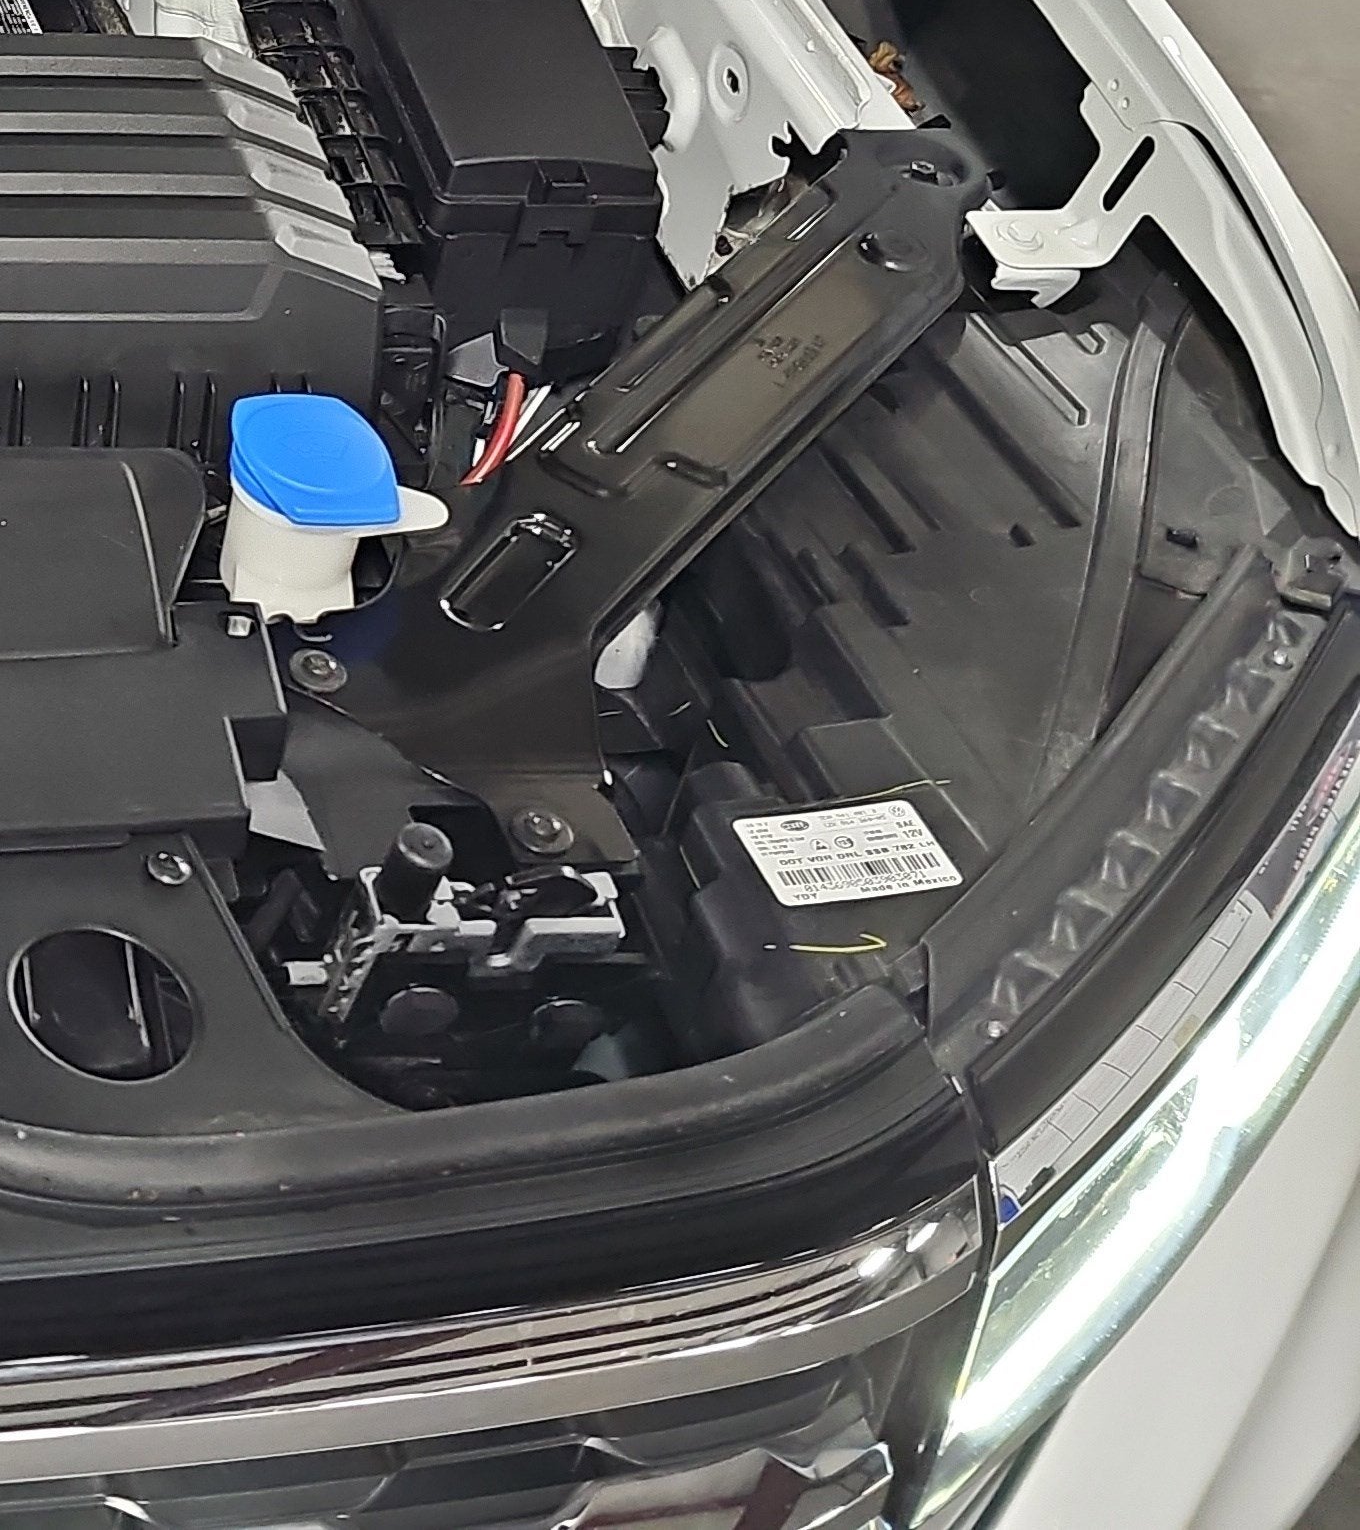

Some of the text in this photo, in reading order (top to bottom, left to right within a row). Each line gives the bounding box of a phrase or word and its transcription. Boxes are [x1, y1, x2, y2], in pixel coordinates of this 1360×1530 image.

[896, 820, 916, 829] SAE
[902, 829, 923, 839] 12V
[778, 857, 804, 866] DOT
[807, 855, 833, 863] VOR
[837, 851, 862, 860] DRL
[892, 844, 917, 853] 782
[919, 840, 936, 849] LH
[860, 884, 893, 894] Made
[915, 875, 957, 887] Mexico
[792, 893, 818, 901] YDY
